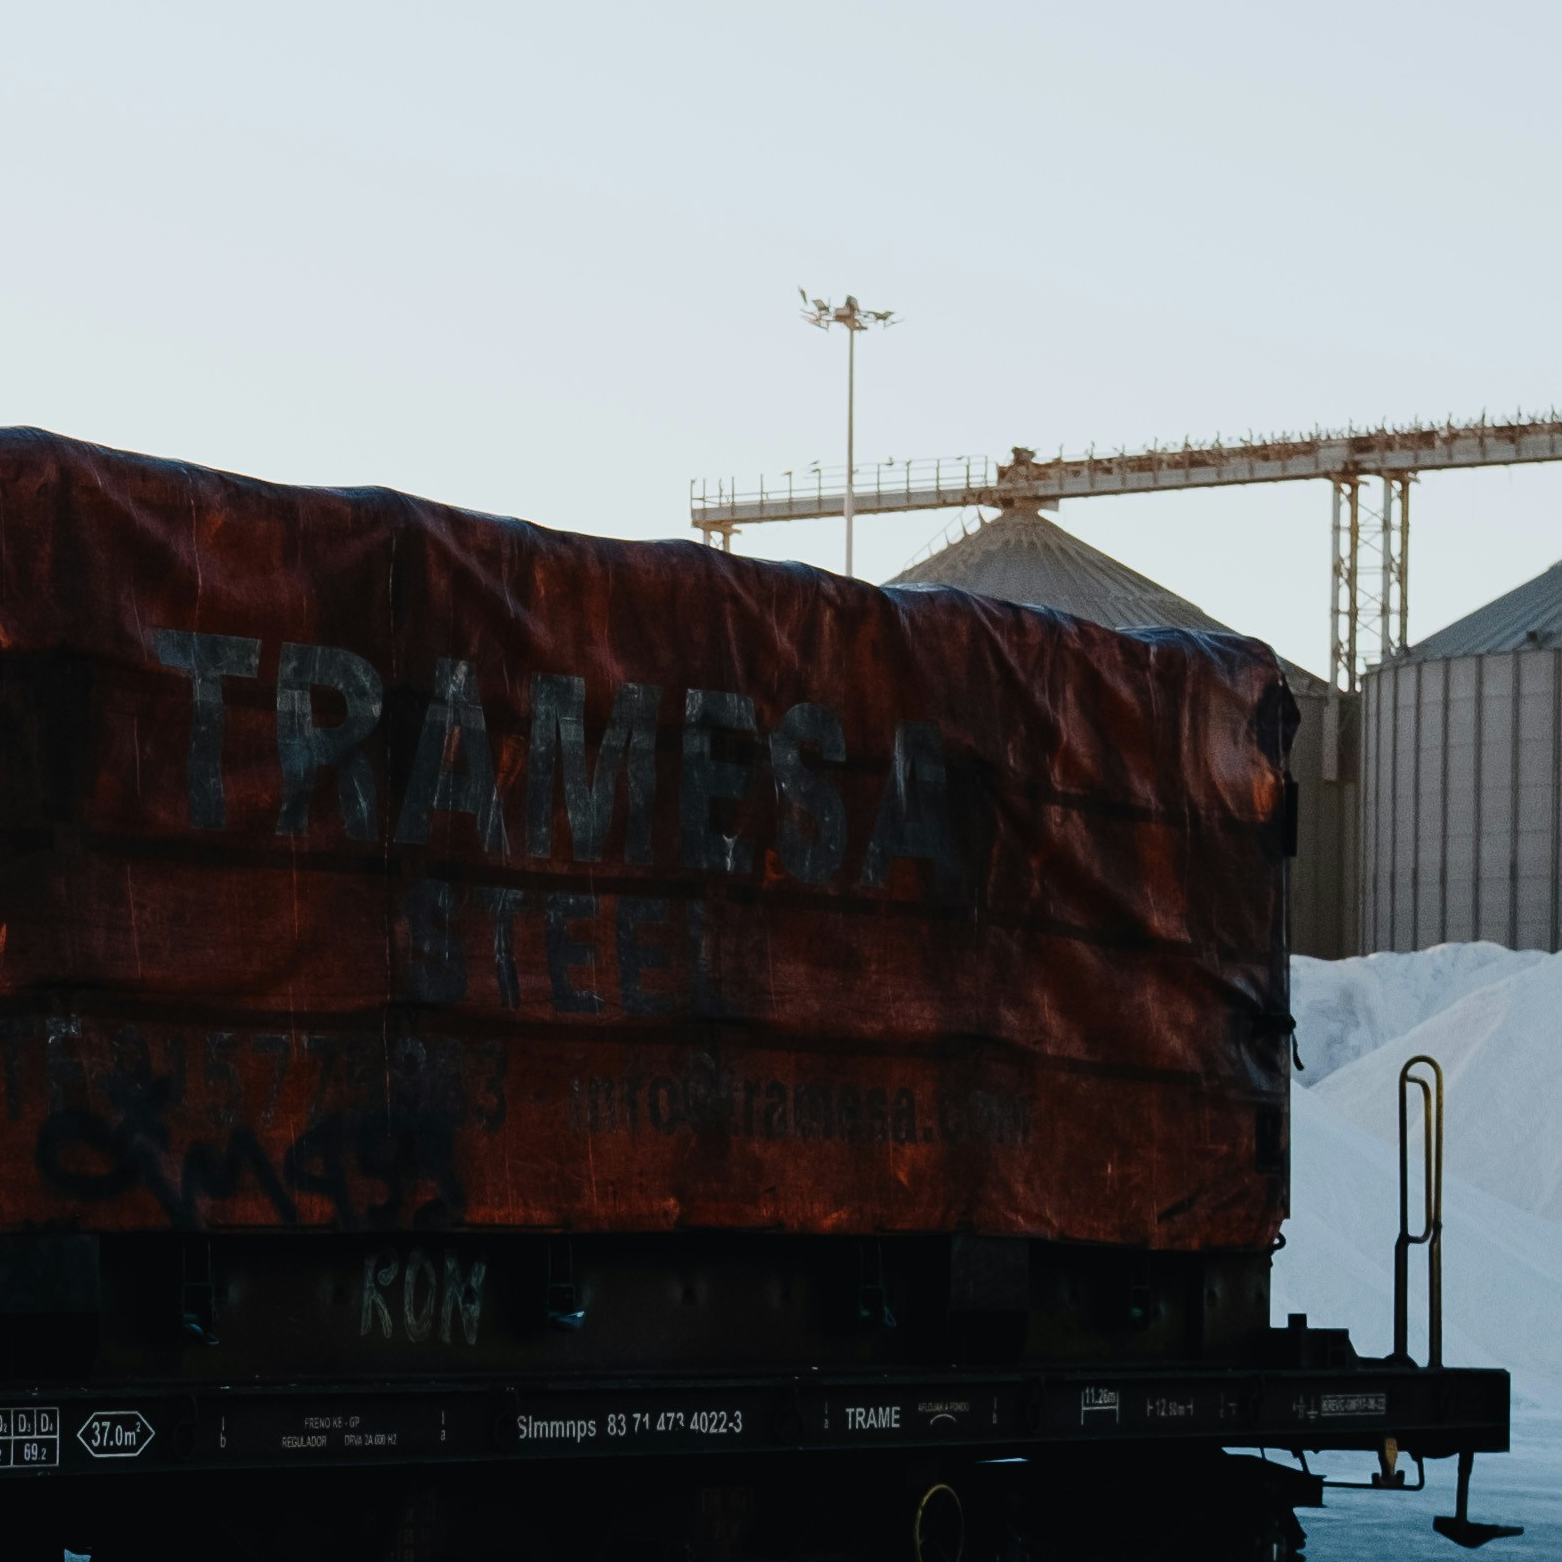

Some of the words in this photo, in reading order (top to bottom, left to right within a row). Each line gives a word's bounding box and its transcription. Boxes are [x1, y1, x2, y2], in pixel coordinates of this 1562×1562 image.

[146, 628, 966, 891] TRAMESA
[401, 878, 740, 1020] STEEL
[305, 1417, 331, 1429] FRENO
[607, 1413, 626, 1437] 83
[632, 1412, 649, 1434] 71
[689, 1410, 742, 1435] 4022-3
[845, 1406, 901, 1430] TRAME
[24, 1443, 47, 1462] 69.2
